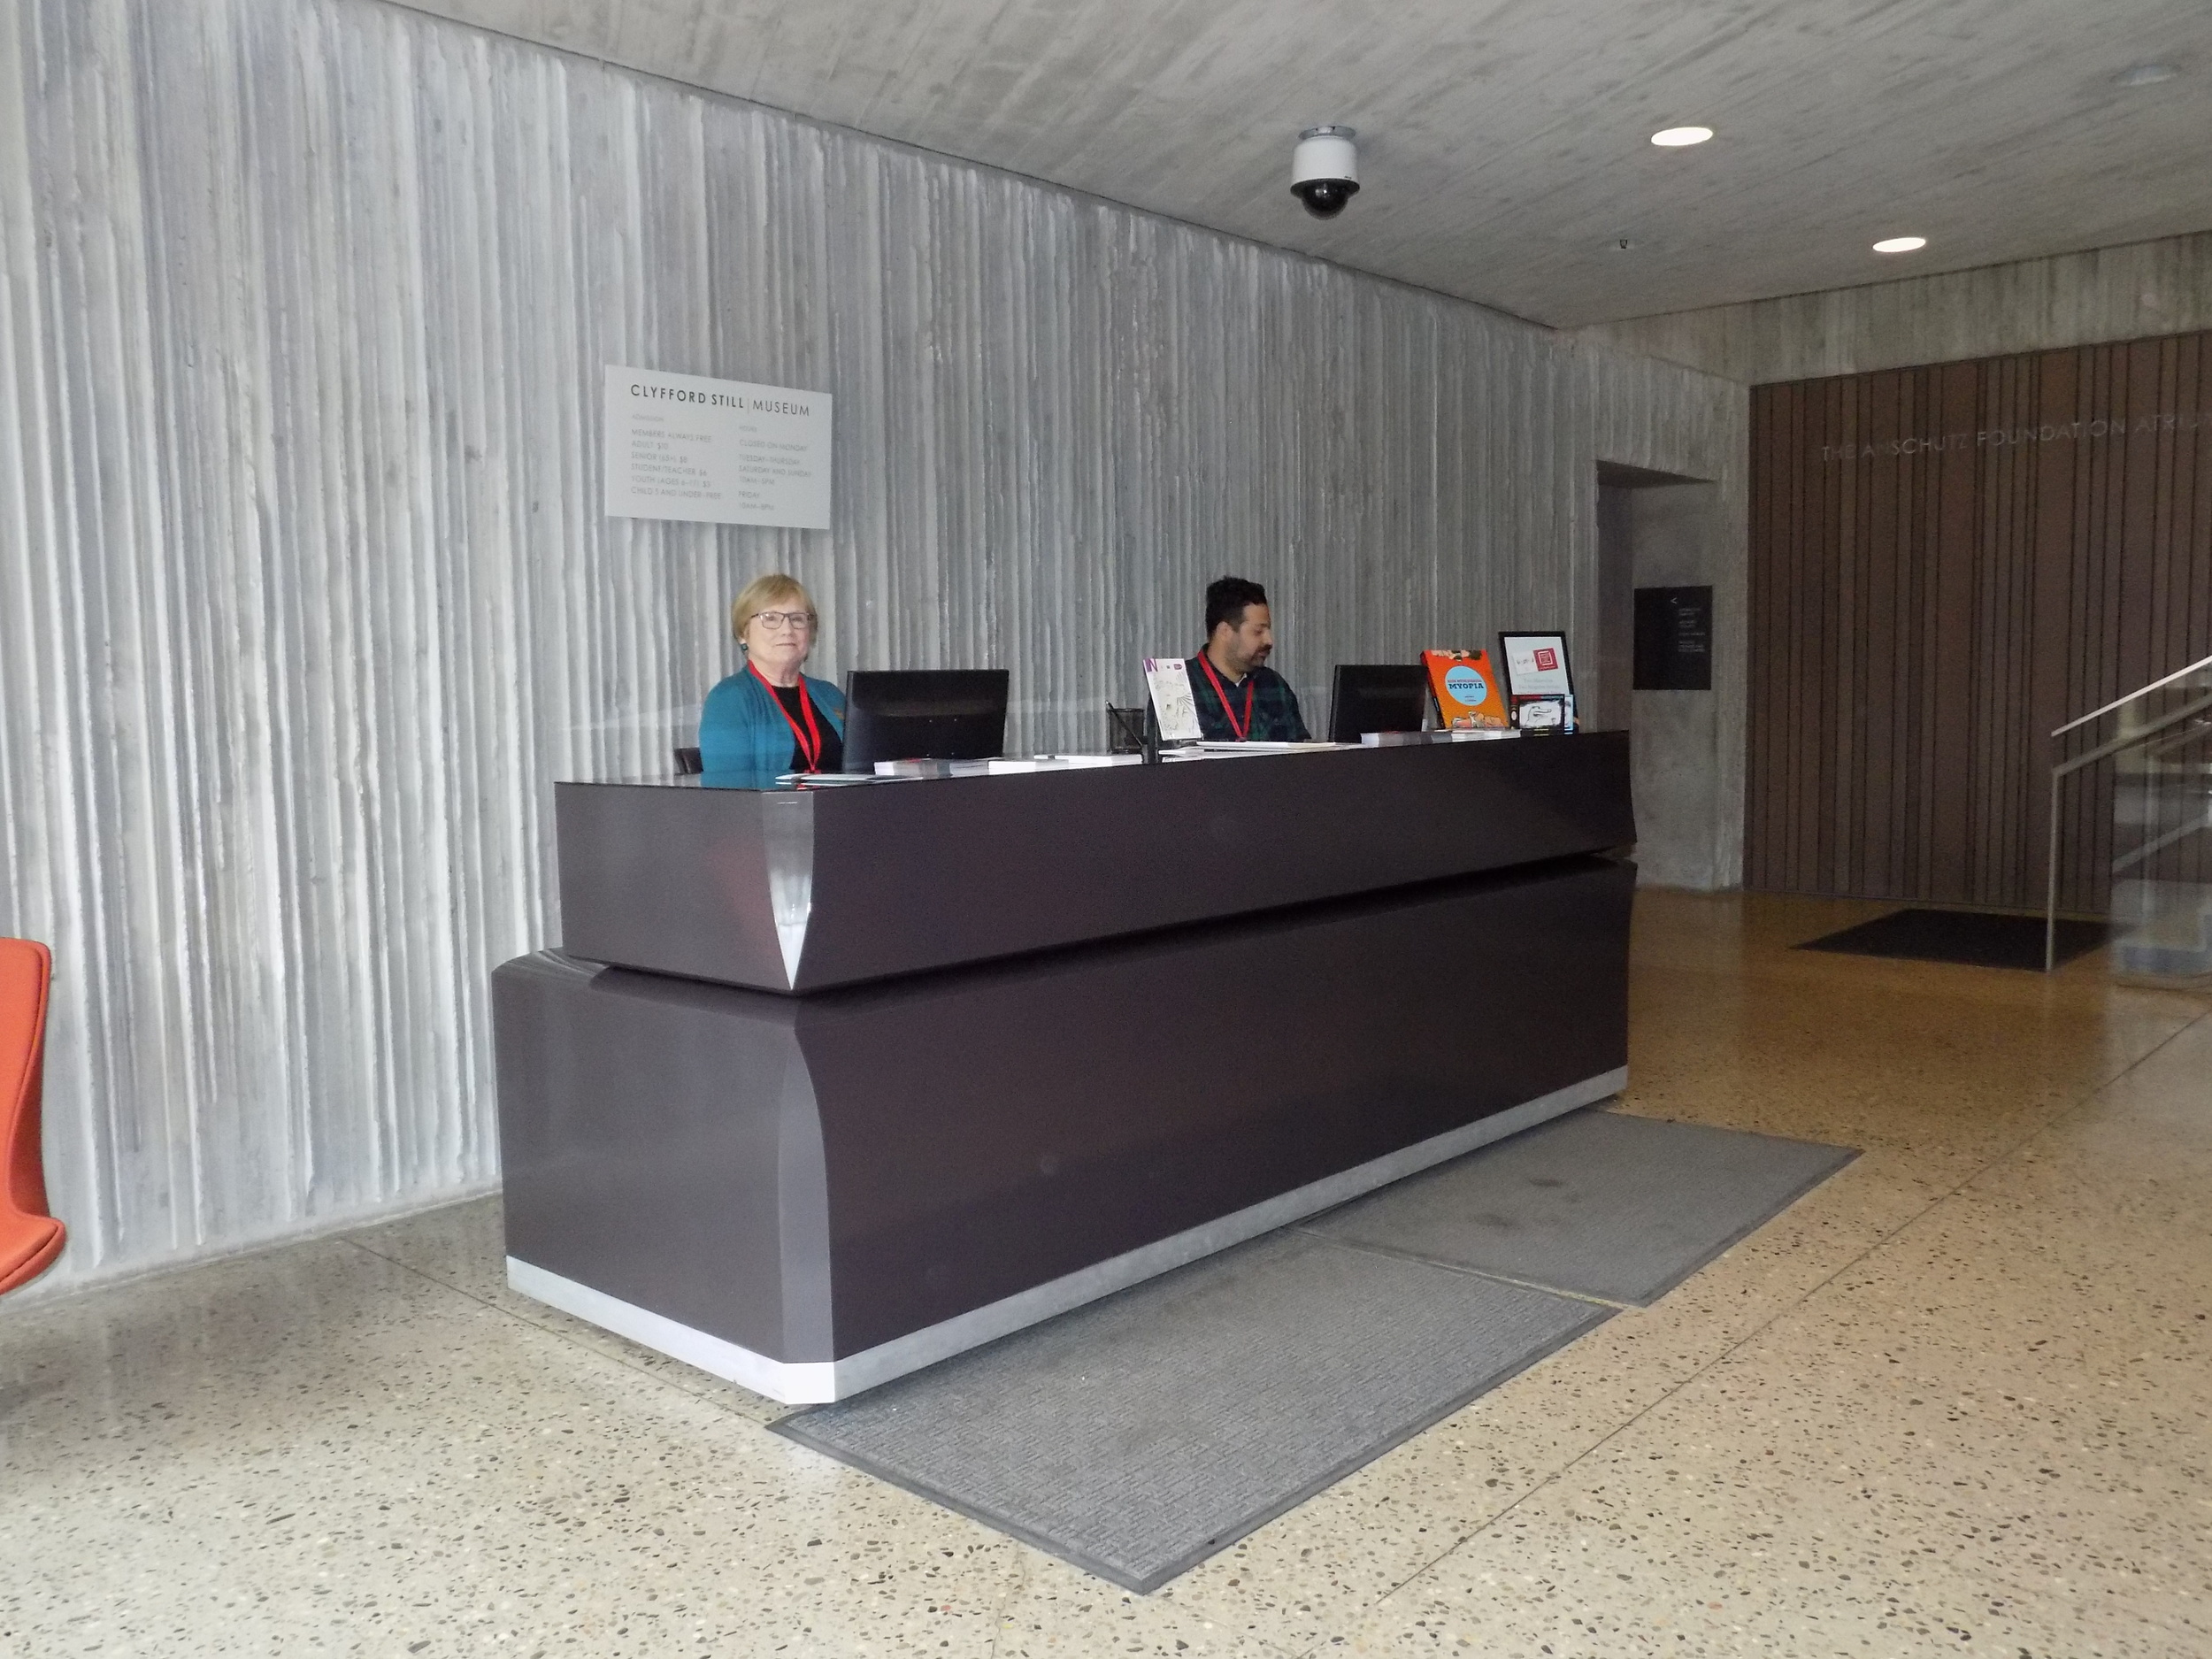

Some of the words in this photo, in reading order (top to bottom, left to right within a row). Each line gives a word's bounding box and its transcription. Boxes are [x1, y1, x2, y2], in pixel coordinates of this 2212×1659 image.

[631, 384, 706, 404] CLYFFORD
[711, 393, 744, 409] STILL
[753, 399, 810, 417] MUSEUM
[631, 429, 664, 438] MEMBERS
[668, 432, 694, 441] ALWAYS
[1821, 444, 1856, 461] THE
[1977, 419, 2125, 447] FOUNDATION
[631, 440, 654, 449] ADULT
[657, 442, 669, 451] $10
[739, 439, 765, 448] CLOSED
[780, 443, 807, 452] MONDAY
[631, 451, 657, 460] SENIOR
[631, 463, 695, 475] STUDENT/TEACHER
[739, 465, 770, 473] SATURDAY
[631, 486, 653, 495] CHILD
